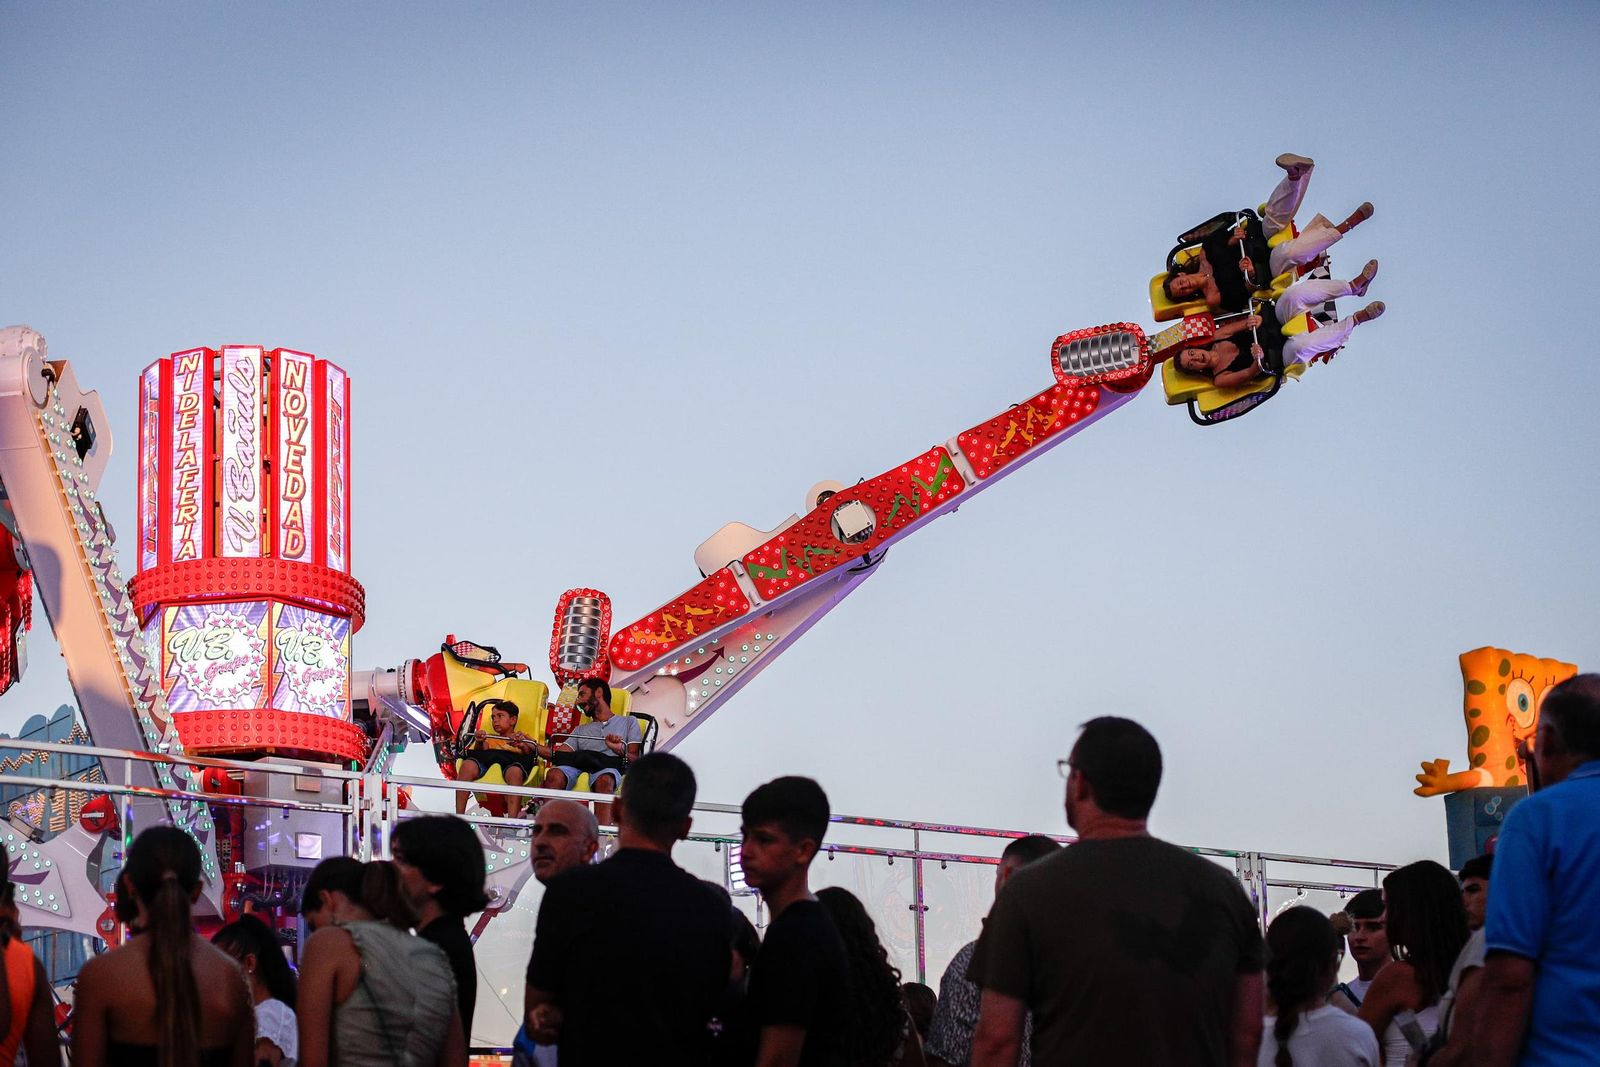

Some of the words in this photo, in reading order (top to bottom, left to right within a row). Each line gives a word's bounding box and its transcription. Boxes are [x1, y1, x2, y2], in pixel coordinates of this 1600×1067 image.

[225, 357, 256, 503] Bañuls
[282, 359, 308, 559] NOVEDAD
[225, 507, 256, 552] V.
[204, 653, 251, 684] Grupo
[302, 666, 337, 687] Grupo
